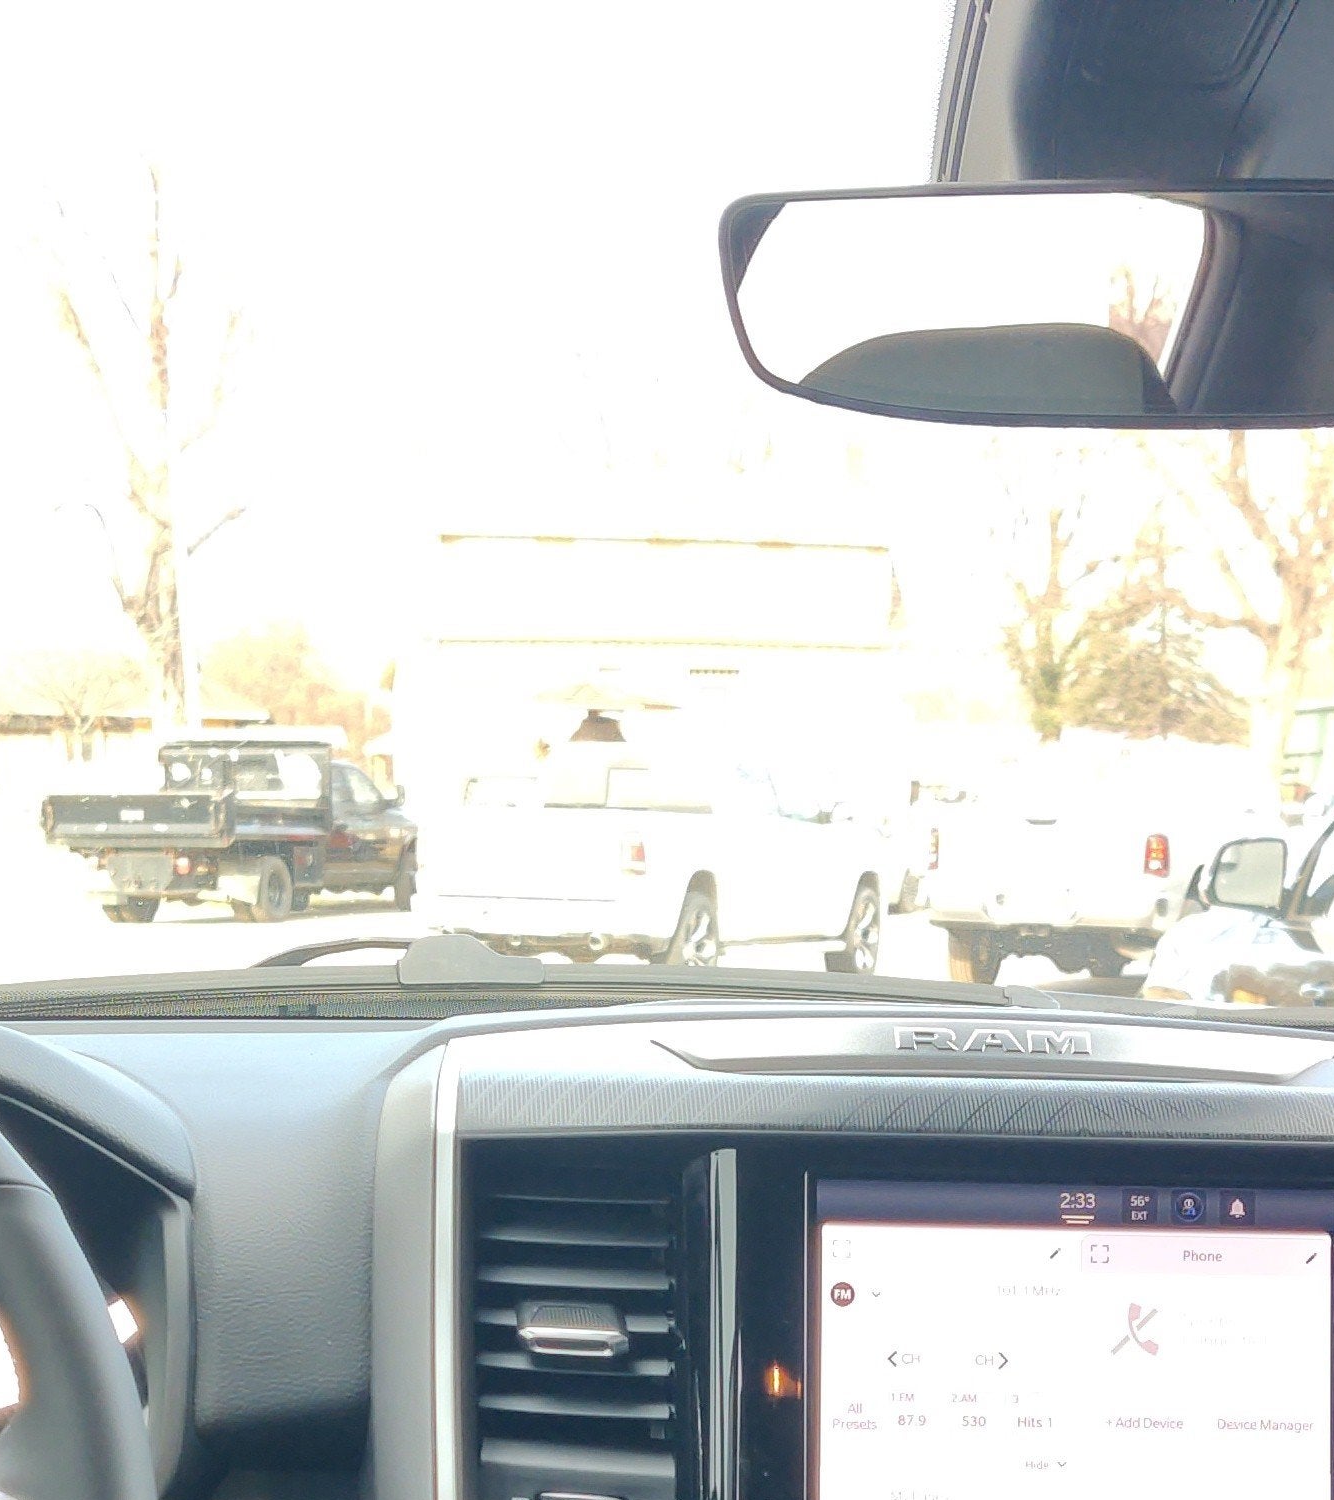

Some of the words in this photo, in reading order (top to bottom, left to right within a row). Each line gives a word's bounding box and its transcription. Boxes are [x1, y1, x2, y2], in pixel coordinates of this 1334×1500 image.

[893, 1026, 1092, 1055] RAM
[1060, 1192, 1096, 1209] 2:33
[1183, 1250, 1223, 1262] Phone
[833, 1288, 852, 1300] FM
[832, 1418, 878, 1430] Presets
[962, 1416, 987, 1427] 530
[1017, 1417, 1043, 1428] Hits
[1115, 1418, 1141, 1429] Add
[1143, 1418, 1184, 1430] Device
[1217, 1418, 1257, 1430] Device
[1259, 1420, 1315, 1433] Manager
